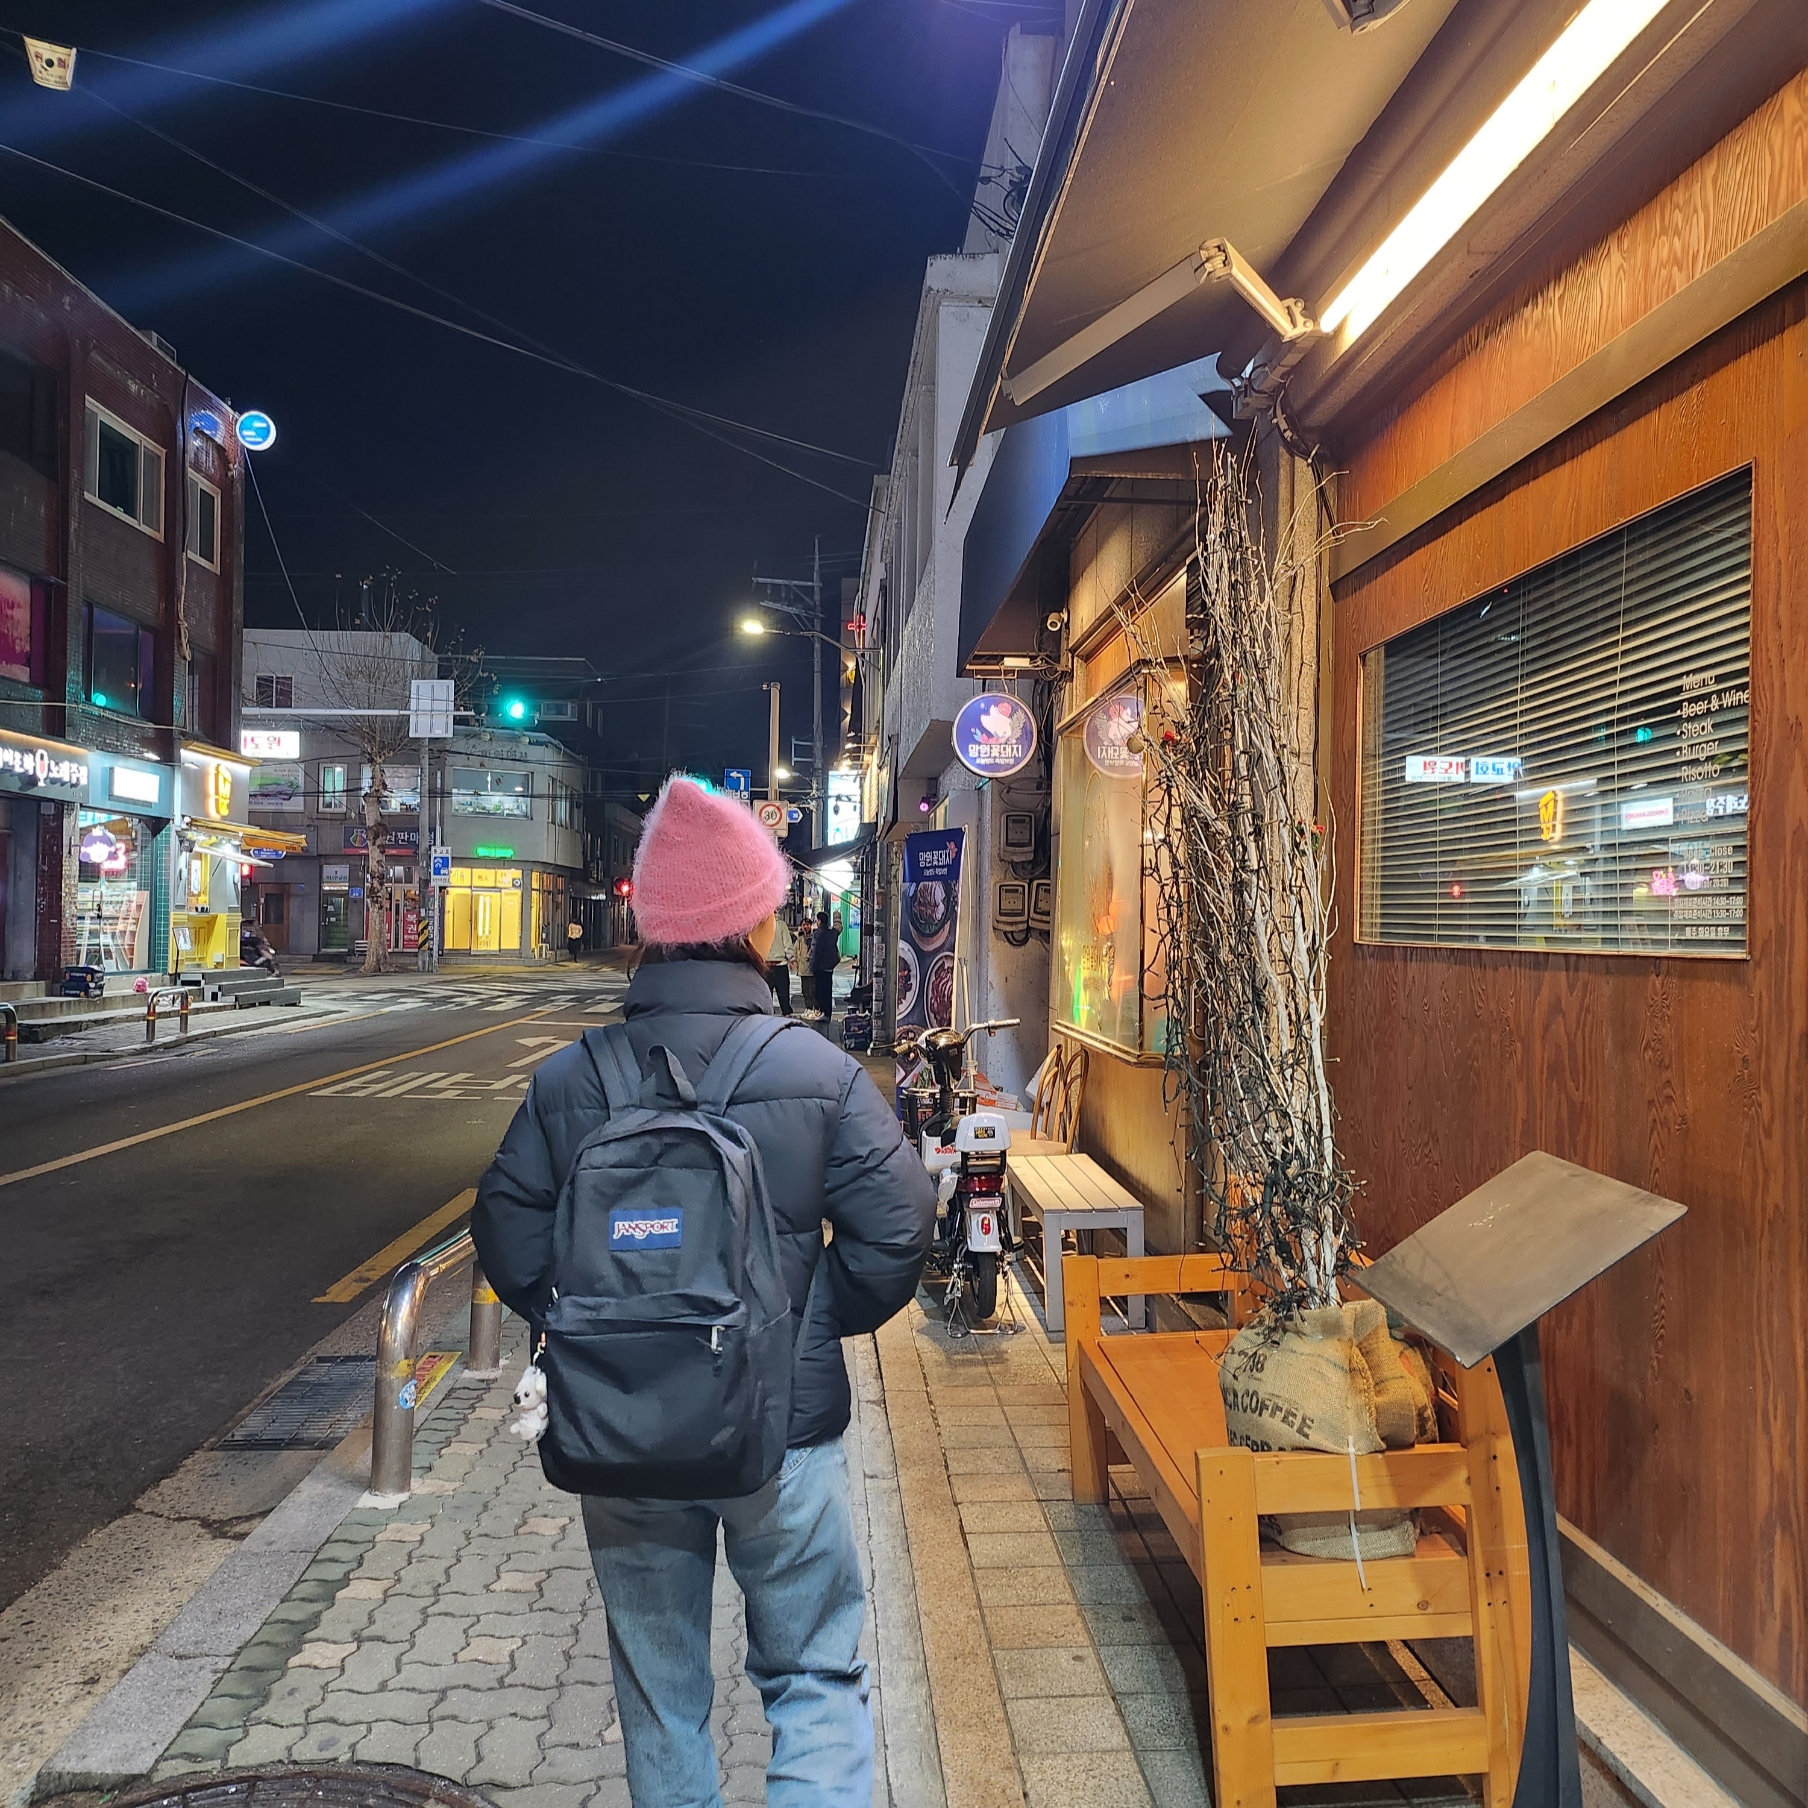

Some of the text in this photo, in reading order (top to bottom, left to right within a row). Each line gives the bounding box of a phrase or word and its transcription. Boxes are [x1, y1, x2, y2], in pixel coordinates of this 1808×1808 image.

[1682, 689, 1750, 718] Beer & Wine
[1682, 717, 1714, 739] Steak
[967, 744, 1022, 758] 망원꽃돼지
[1682, 740, 1719, 761] Burger
[1681, 761, 1720, 782] Risotto
[763, 810, 778, 821] 30
[919, 849, 953, 868] 망원꽃돼지
[1709, 846, 1734, 857] Close
[613, 1218, 678, 1239] JANSPORT
[1240, 1388, 1315, 1441] COFFEE
